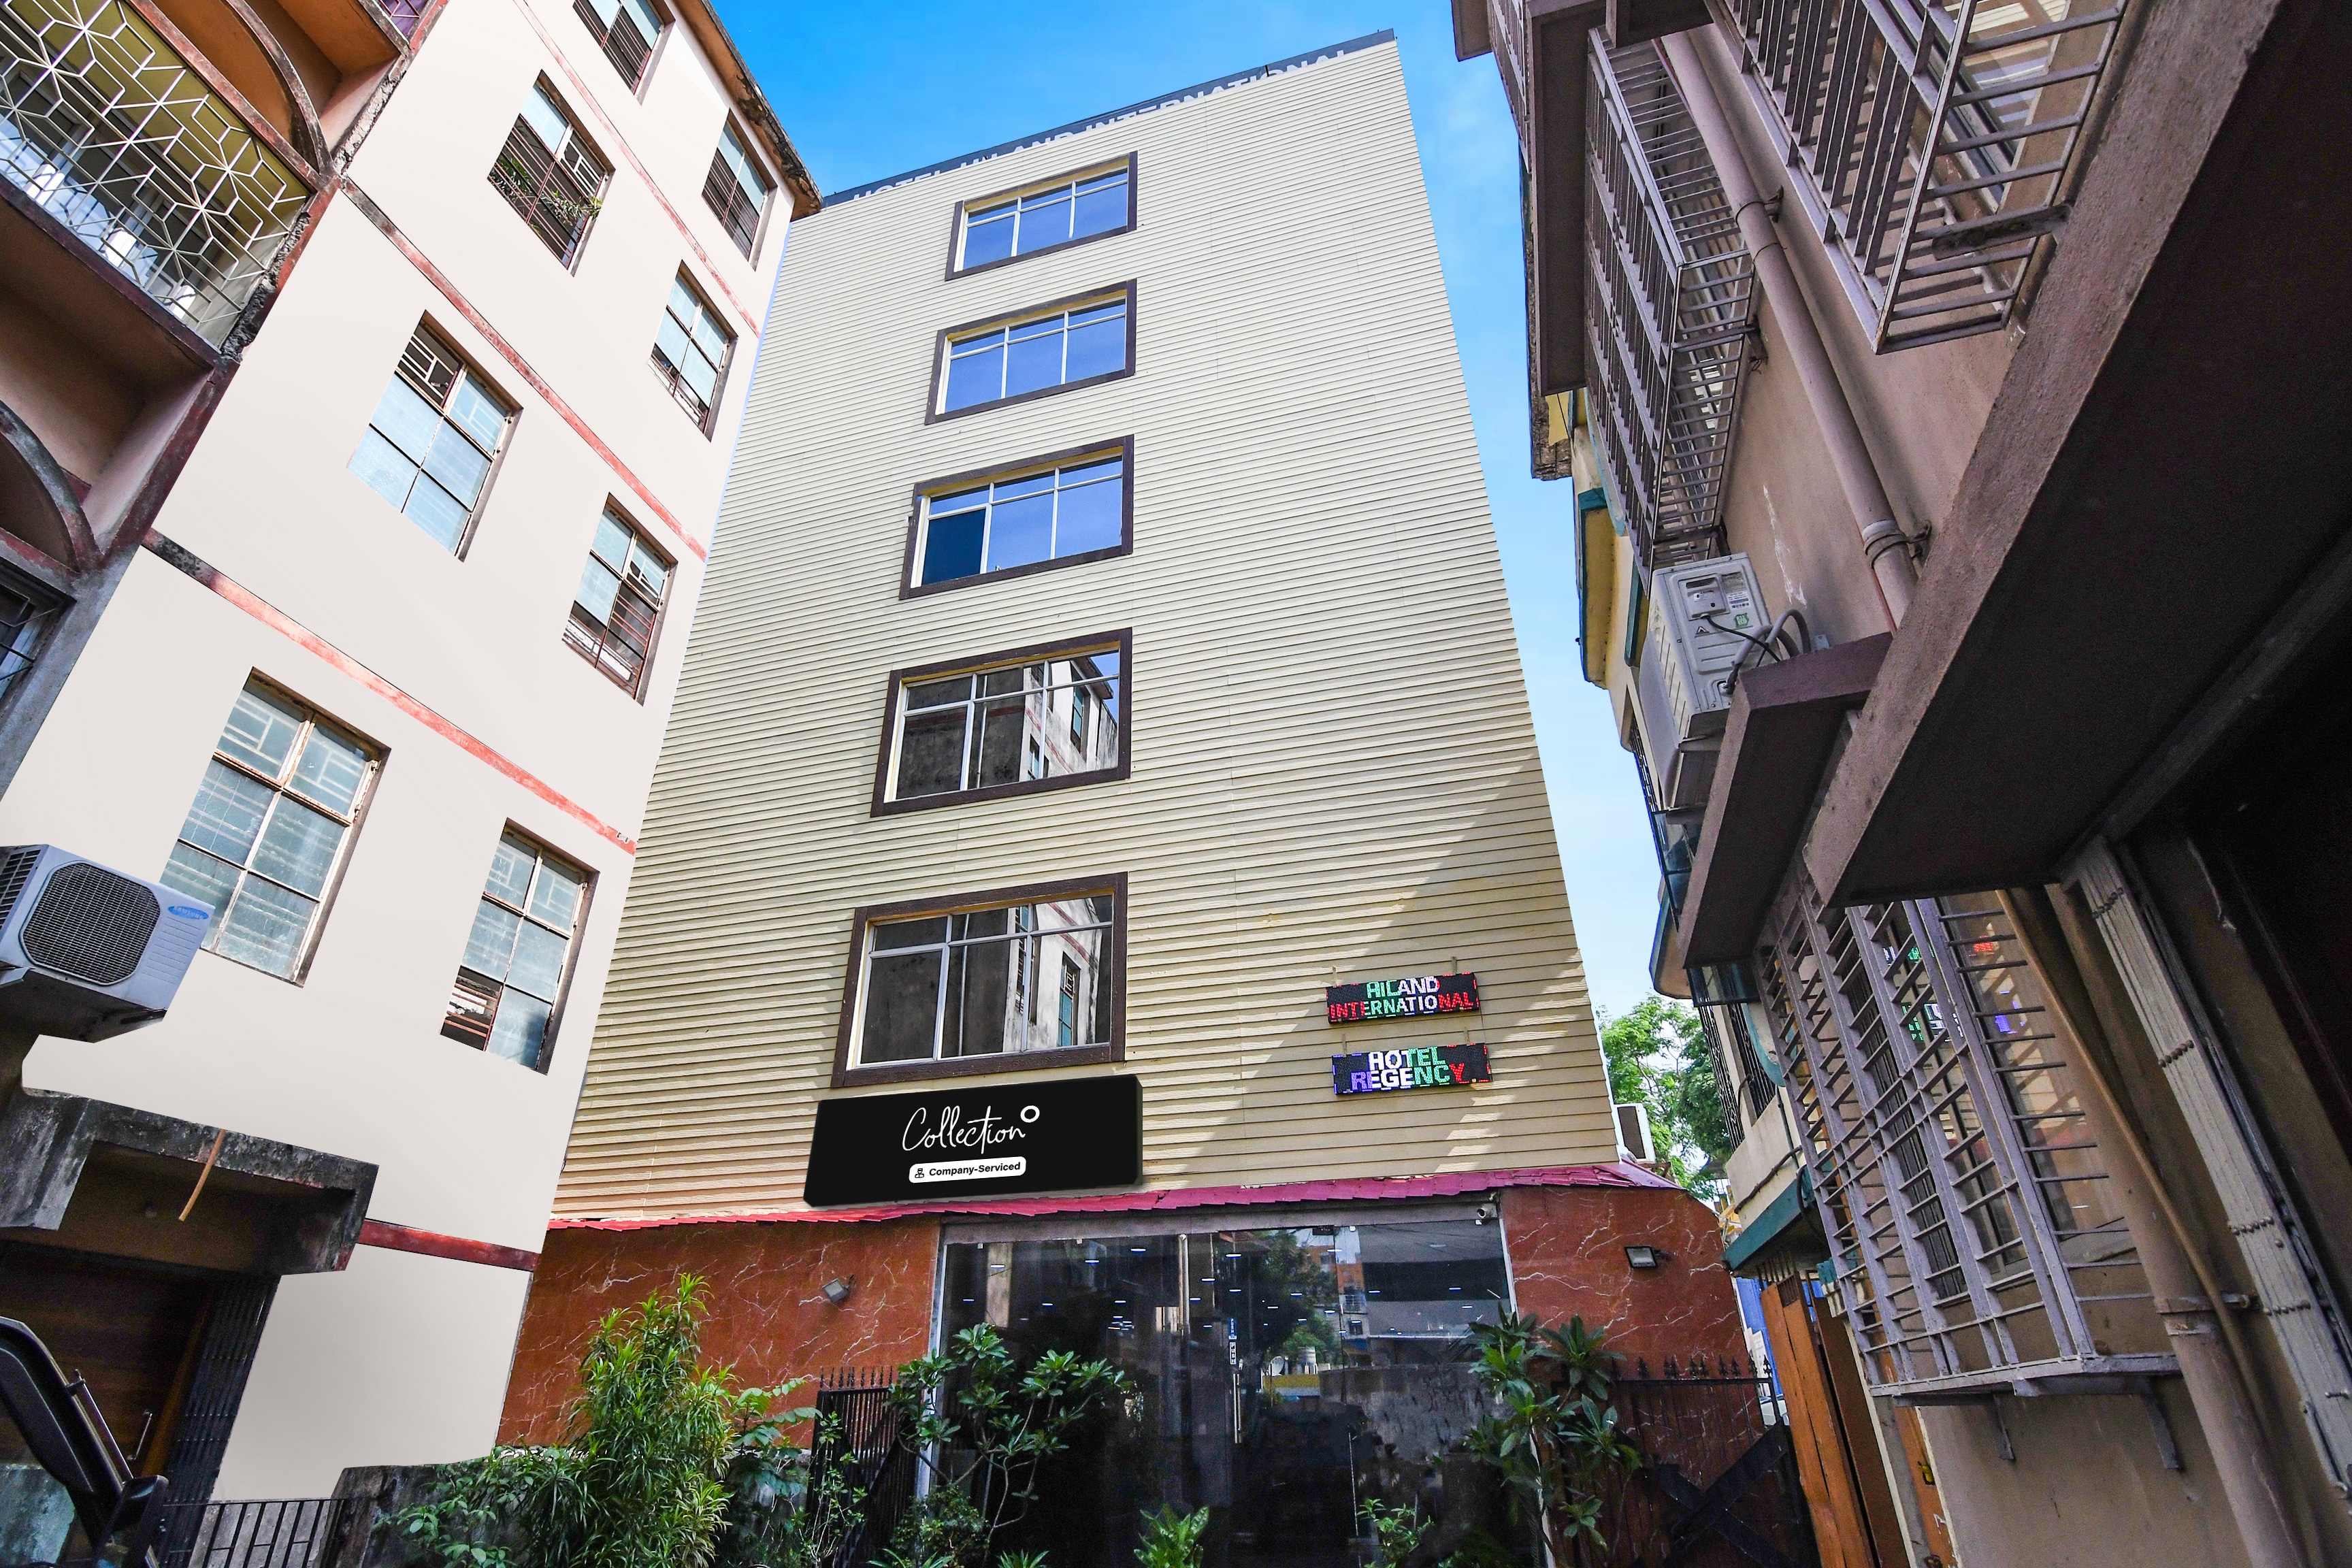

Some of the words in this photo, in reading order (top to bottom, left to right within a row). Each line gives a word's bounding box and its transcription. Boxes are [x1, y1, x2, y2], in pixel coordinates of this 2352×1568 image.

[172, 906, 204, 919] SAMSUNG
[1329, 992, 1474, 1018] INTERNATIONAL
[1351, 1063, 1465, 1091] REGENCY
[902, 1105, 1026, 1154] Collection
[929, 1162, 1021, 1177] Company-Serviced
